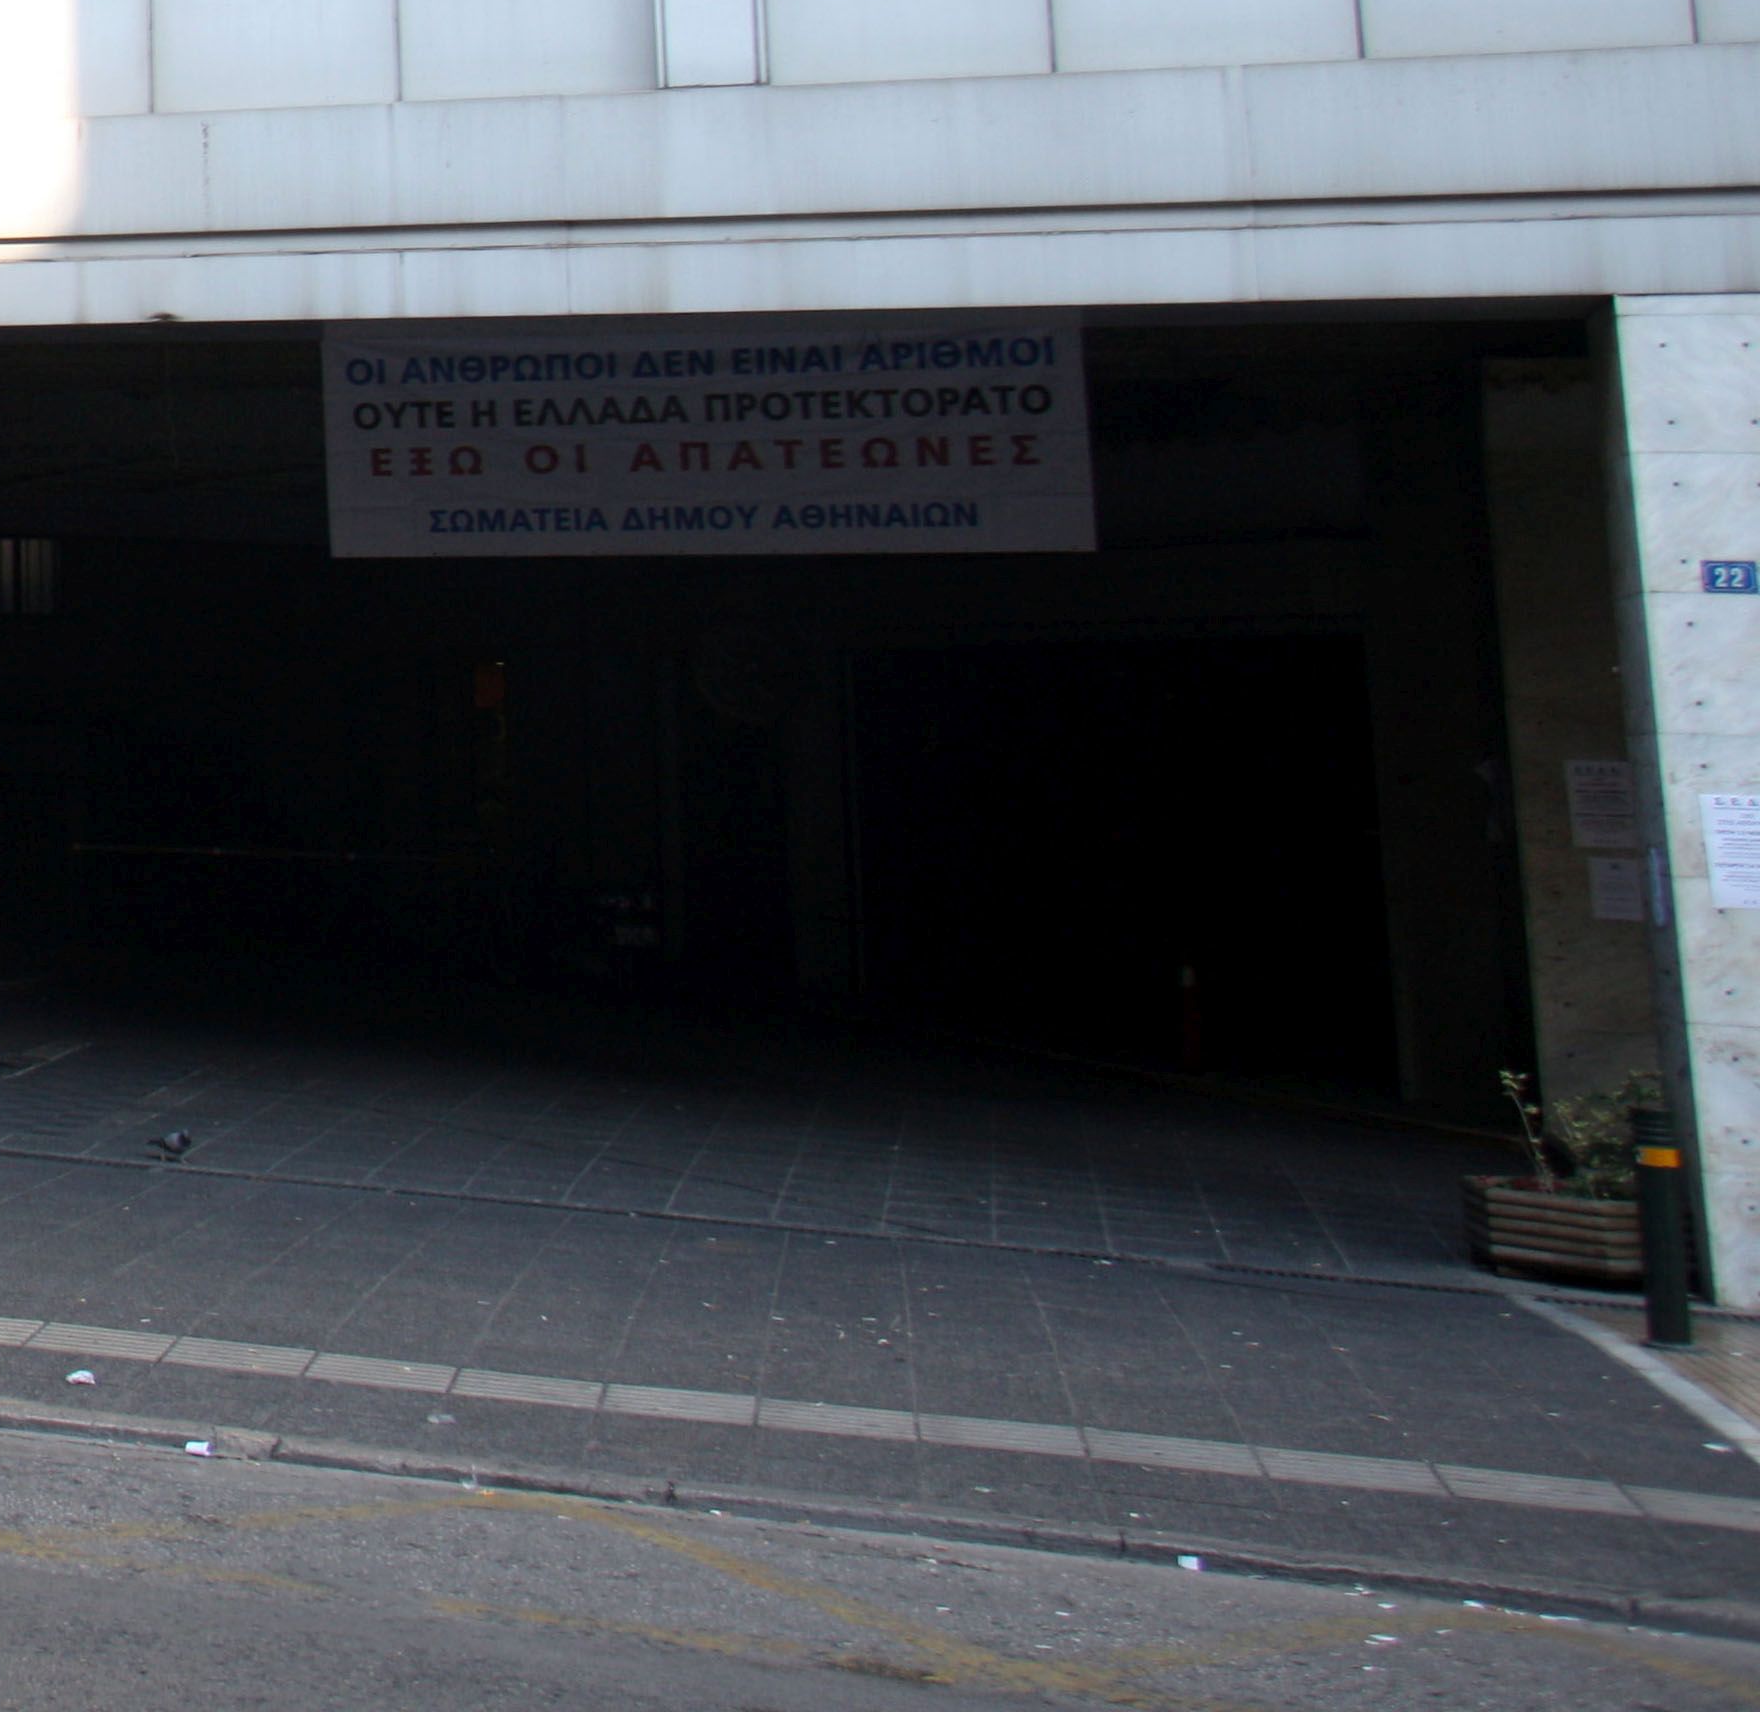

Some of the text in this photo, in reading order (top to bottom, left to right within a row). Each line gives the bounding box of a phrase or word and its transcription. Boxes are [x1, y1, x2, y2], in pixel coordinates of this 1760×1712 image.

[346, 336, 1055, 386] ΟΙ ΑΝΘΡΩΠΟΙ ΔΕΝ ΕΙΝΑΙ ΑΡΙΘΜΟΙ
[353, 384, 1053, 430] ΟΥΤΕ Η ΕΛΛΑΔΑ ΠΡΟΤΕΚΤΟΡΑΤΟ
[371, 434, 1041, 476] ΕΞΩ ΟΙ ΑΠΑΤΕΩΝΕΣ
[430, 501, 978, 533] ΣΩΜΑΤΕΙΑ ΔΗΜΟΥ ΑΘΗΝΑΙΩΝ
[1714, 567, 1744, 588] 22
